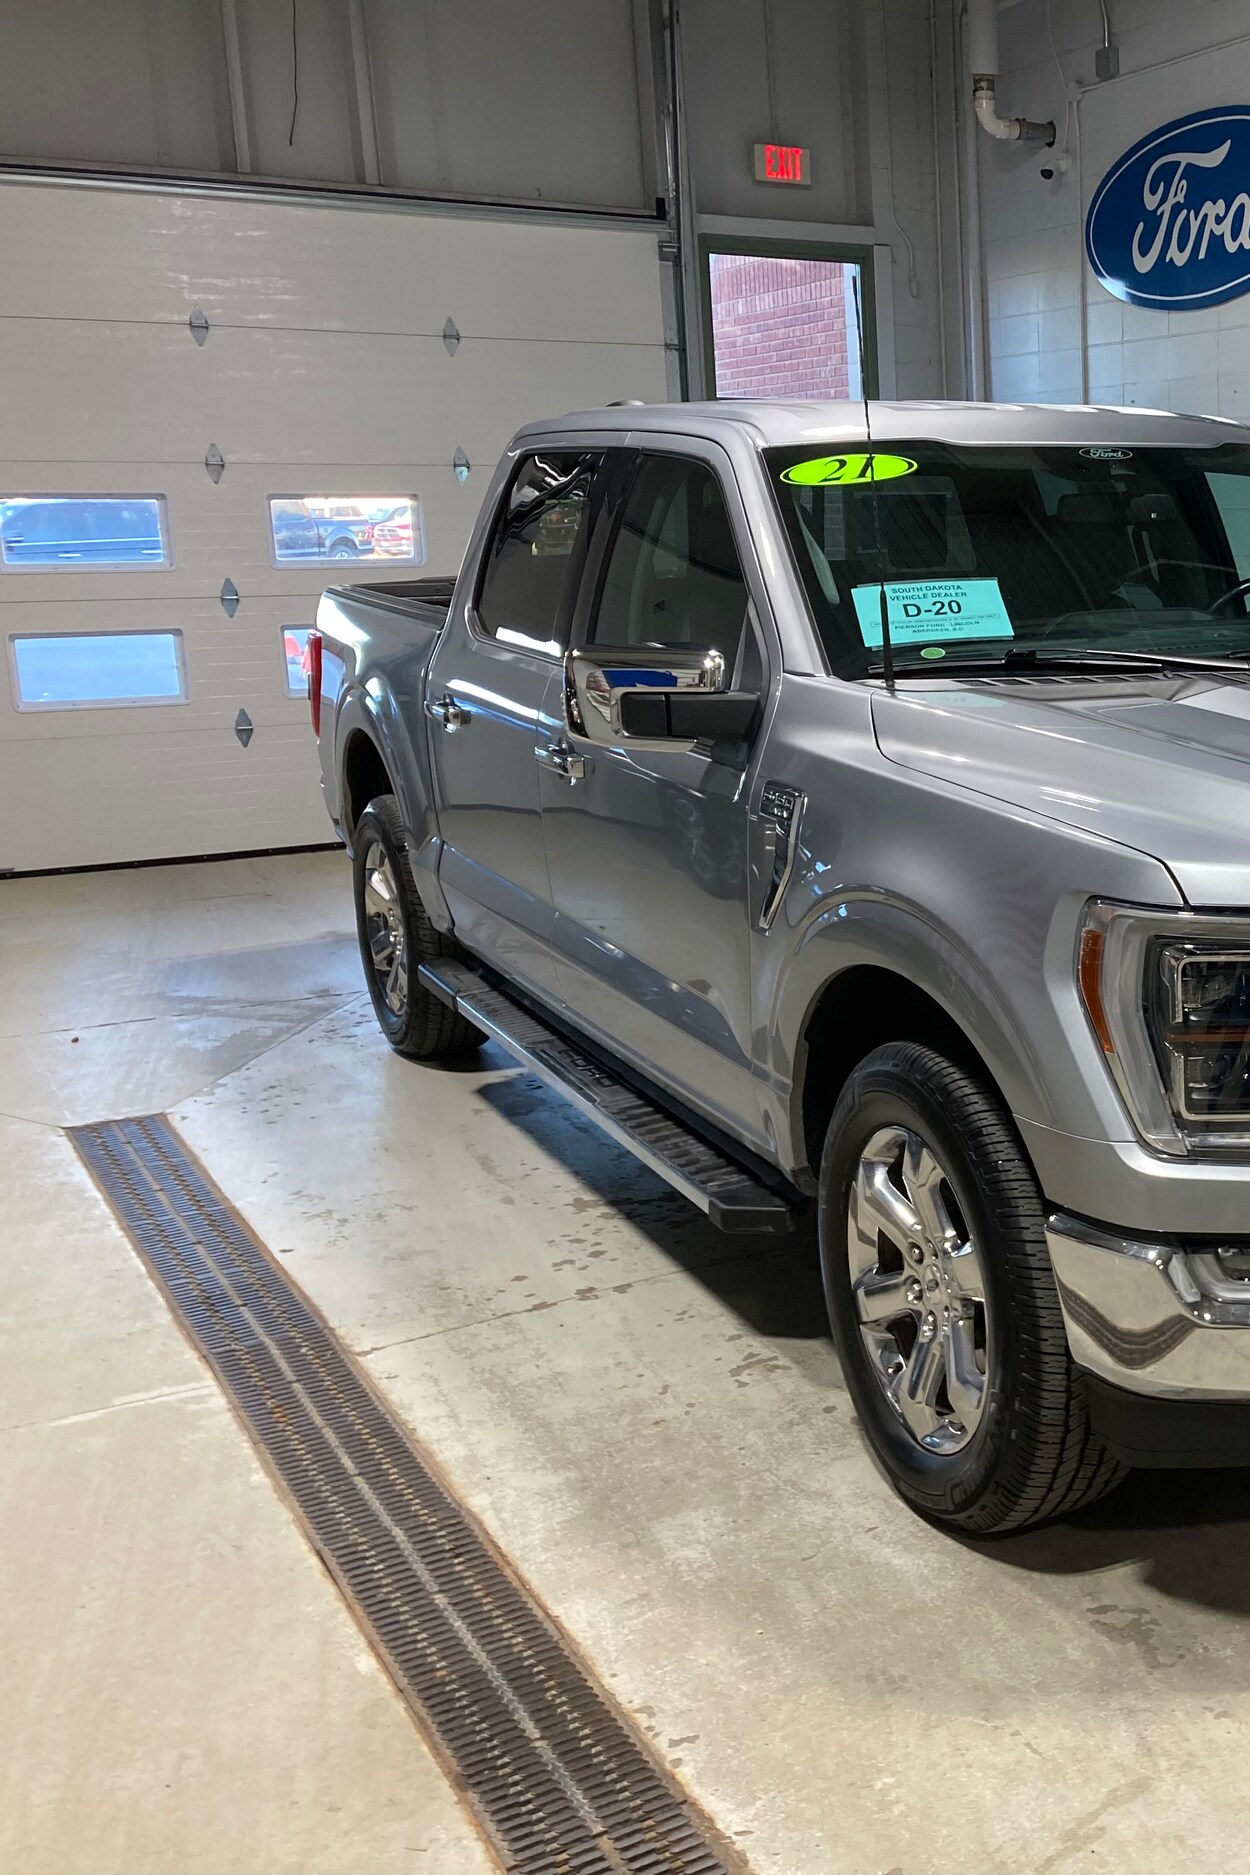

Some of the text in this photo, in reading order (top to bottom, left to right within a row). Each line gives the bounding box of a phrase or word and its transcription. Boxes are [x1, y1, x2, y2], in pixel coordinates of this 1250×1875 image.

[765, 144, 802, 181] EXIT
[1090, 448, 1124, 458] Ford
[817, 455, 875, 483] 21
[889, 593, 928, 601] VEHICLE
[891, 586, 924, 594] SOUTH
[902, 600, 962, 618] D-20
